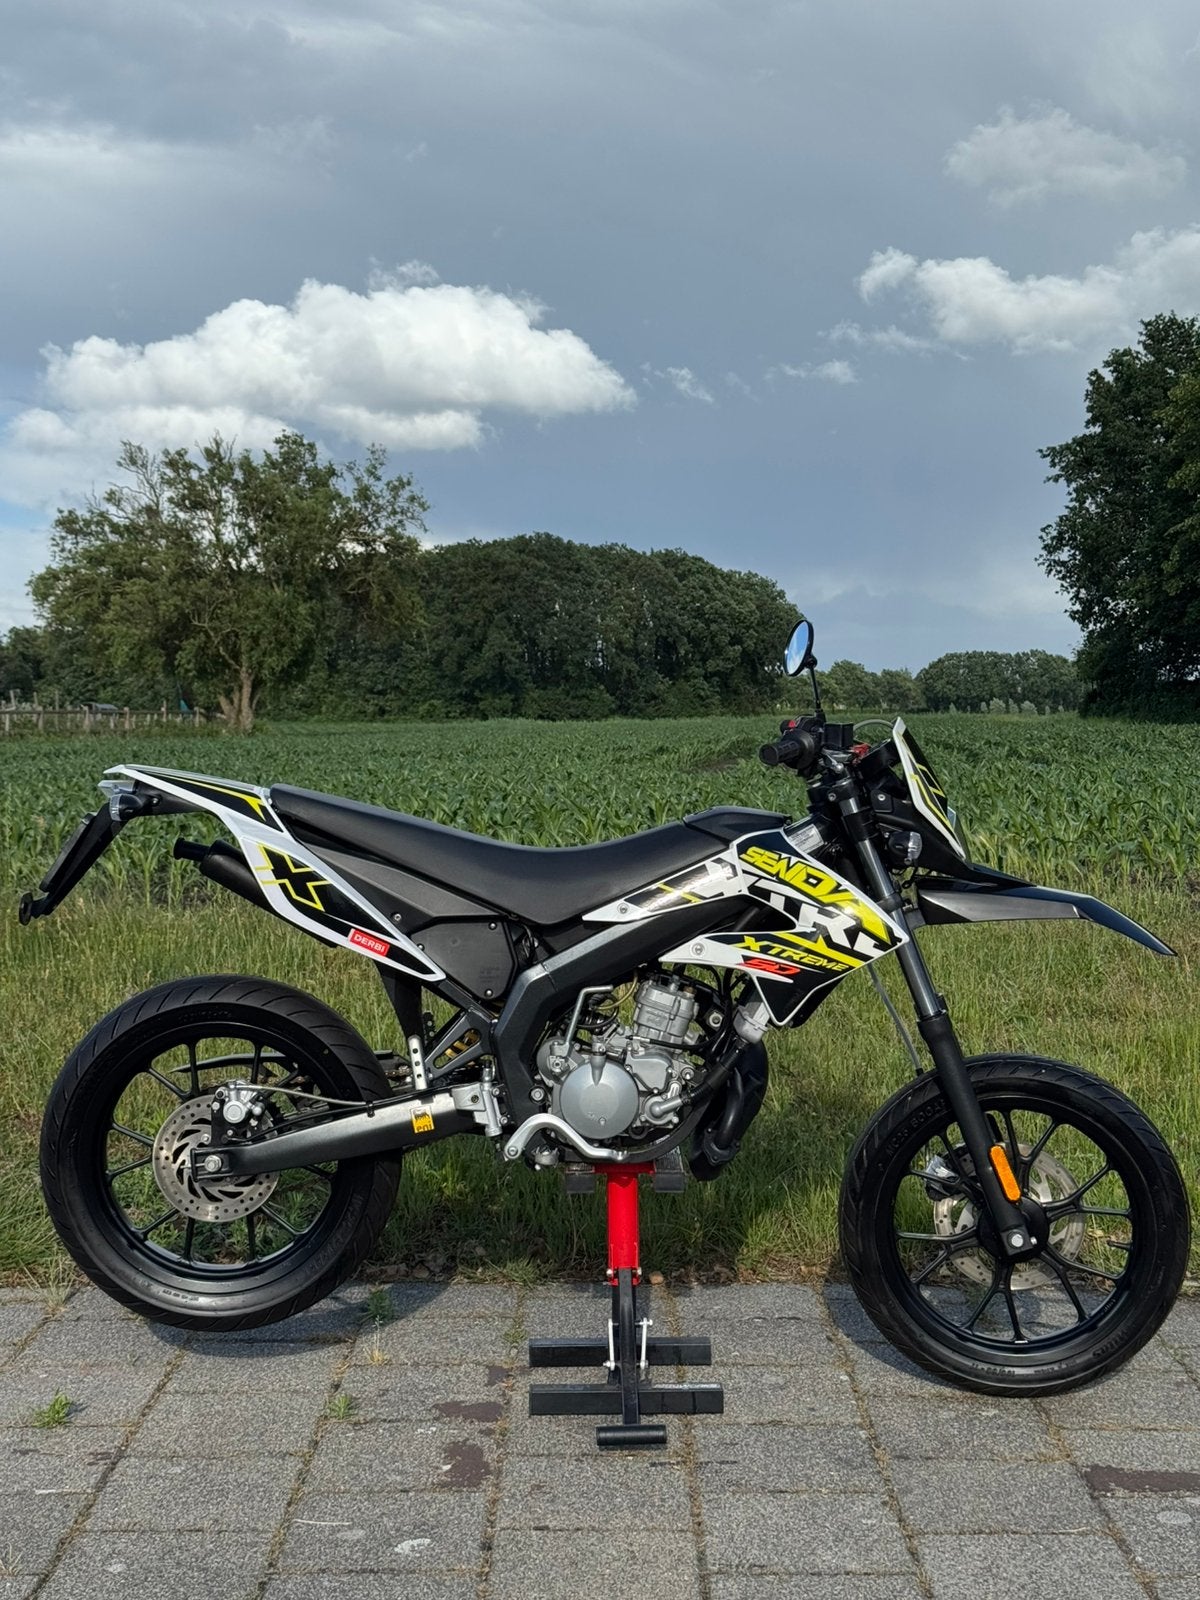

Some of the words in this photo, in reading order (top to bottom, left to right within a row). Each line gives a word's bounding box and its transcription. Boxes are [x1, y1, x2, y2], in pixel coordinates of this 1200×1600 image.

[740, 845, 893, 945] SENDA
[353, 933, 387, 953] DERBI
[733, 934, 850, 972] XTREME
[737, 958, 801, 977] 50
[416, 1120, 433, 1132] eni
